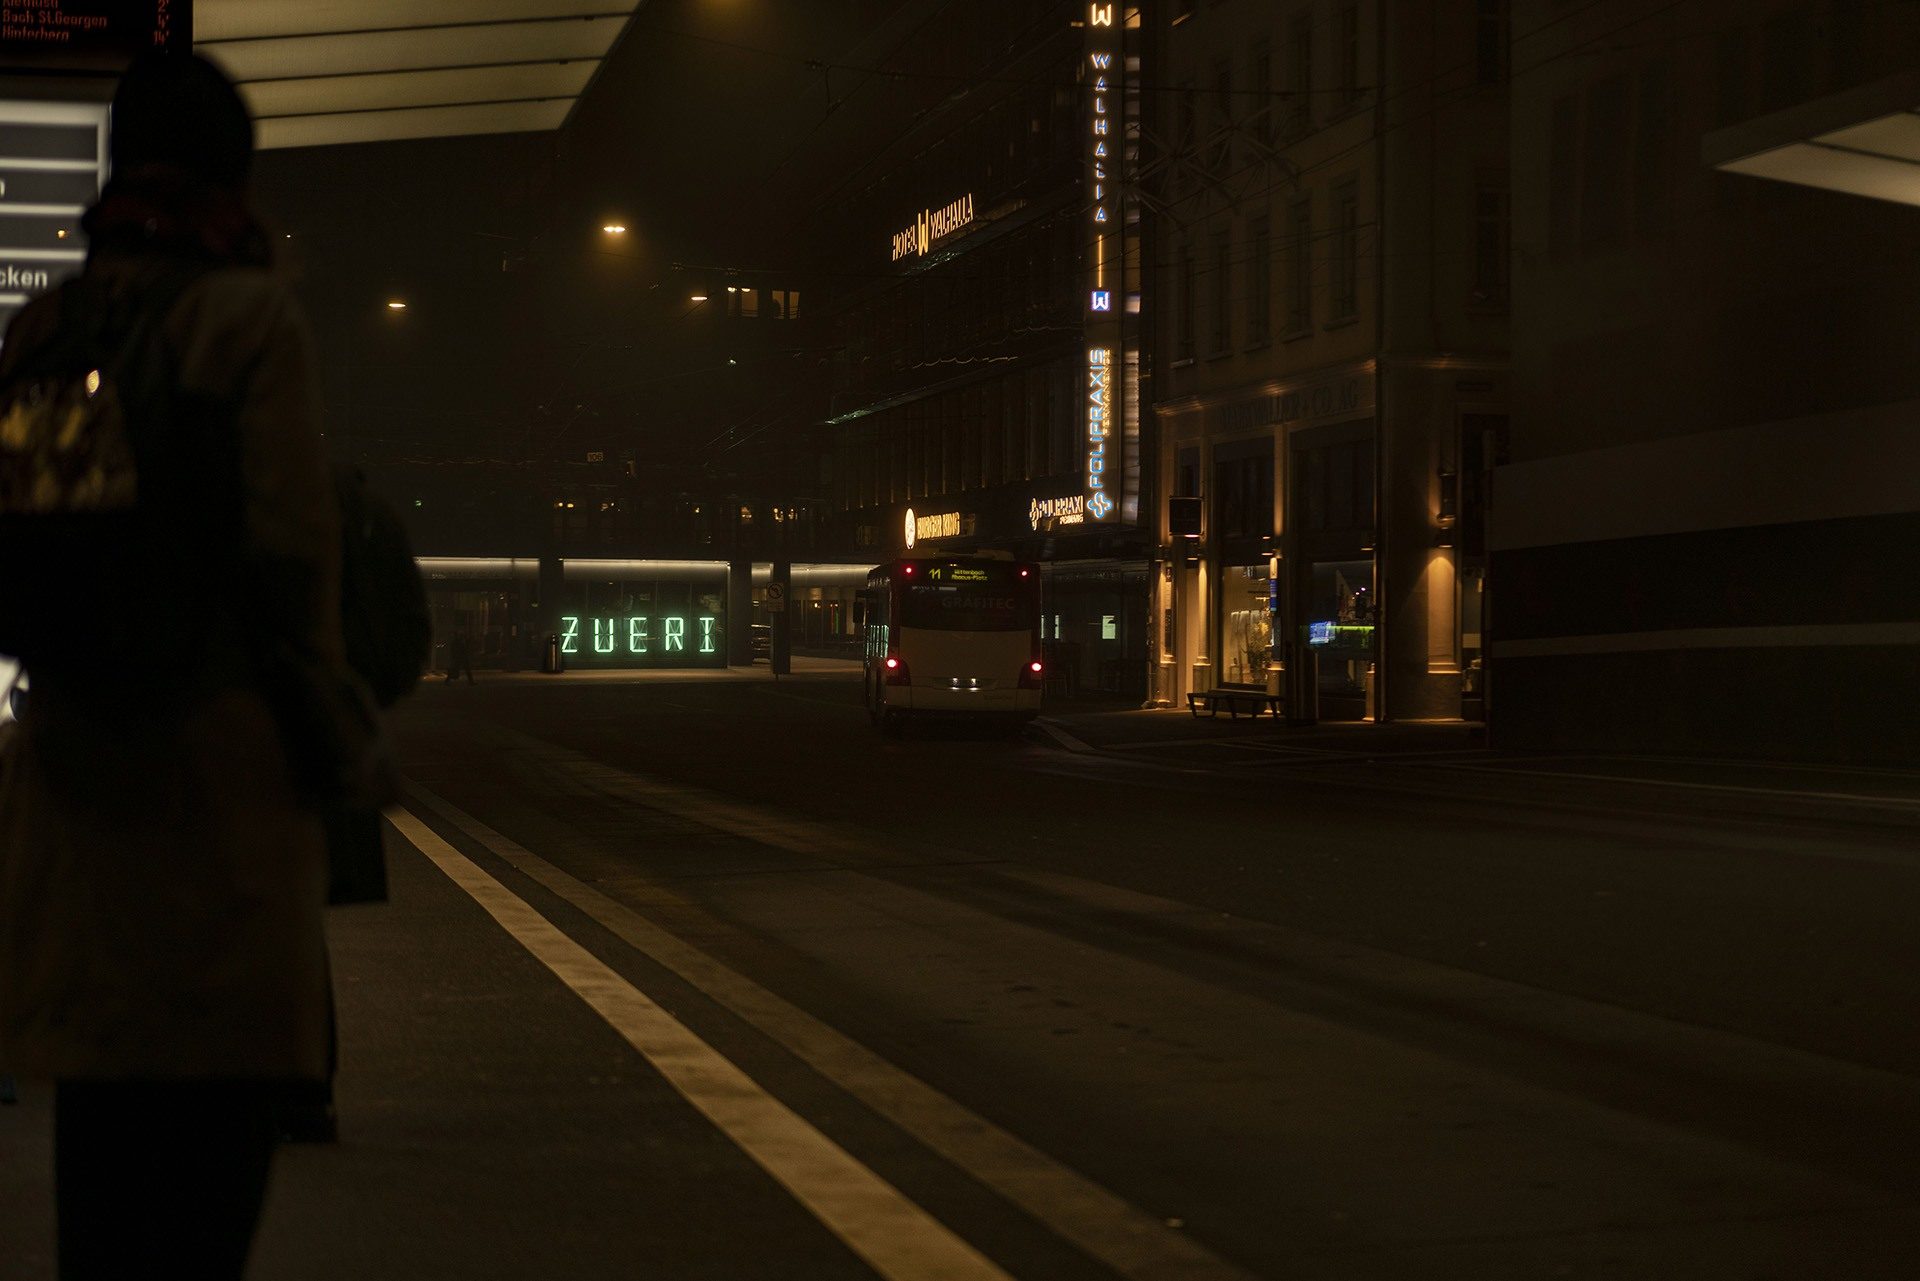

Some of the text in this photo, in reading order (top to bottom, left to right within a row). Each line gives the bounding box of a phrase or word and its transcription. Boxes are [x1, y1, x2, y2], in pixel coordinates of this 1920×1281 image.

[1091, 53, 1112, 222] WALHALLA
[892, 224, 918, 262] HOTEL
[930, 192, 974, 241] WALHALLA
[1089, 348, 1105, 489] POLIPRAXIS
[916, 514, 943, 540] BURGER
[942, 511, 961, 537] KING
[928, 567, 942, 580] 11
[561, 616, 715, 653] ZUERI
